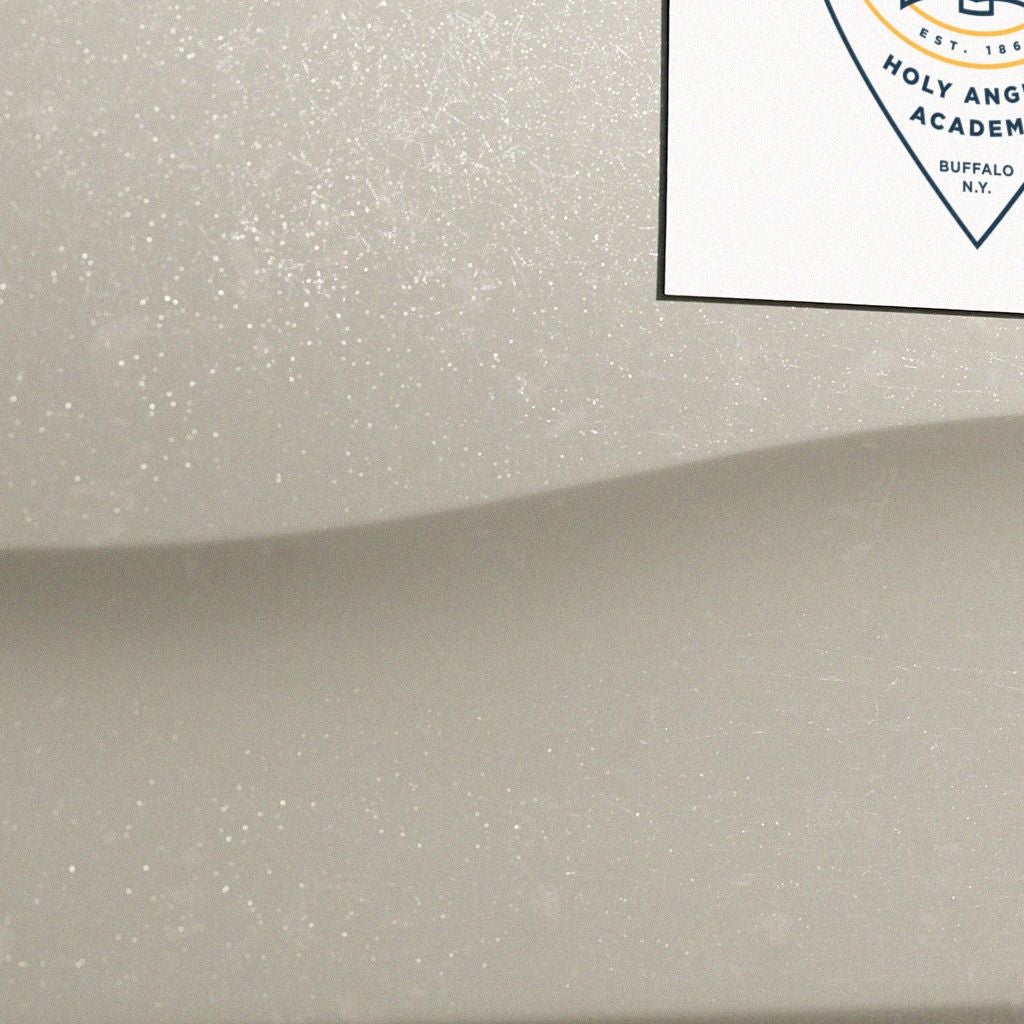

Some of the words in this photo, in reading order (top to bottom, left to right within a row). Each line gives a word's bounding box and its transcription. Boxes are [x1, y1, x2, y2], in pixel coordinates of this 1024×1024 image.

[919, 27, 968, 54] EST.
[882, 53, 953, 99] HOLY
[939, 159, 1015, 177] BUFFALO
[962, 180, 992, 194] N.Y.
